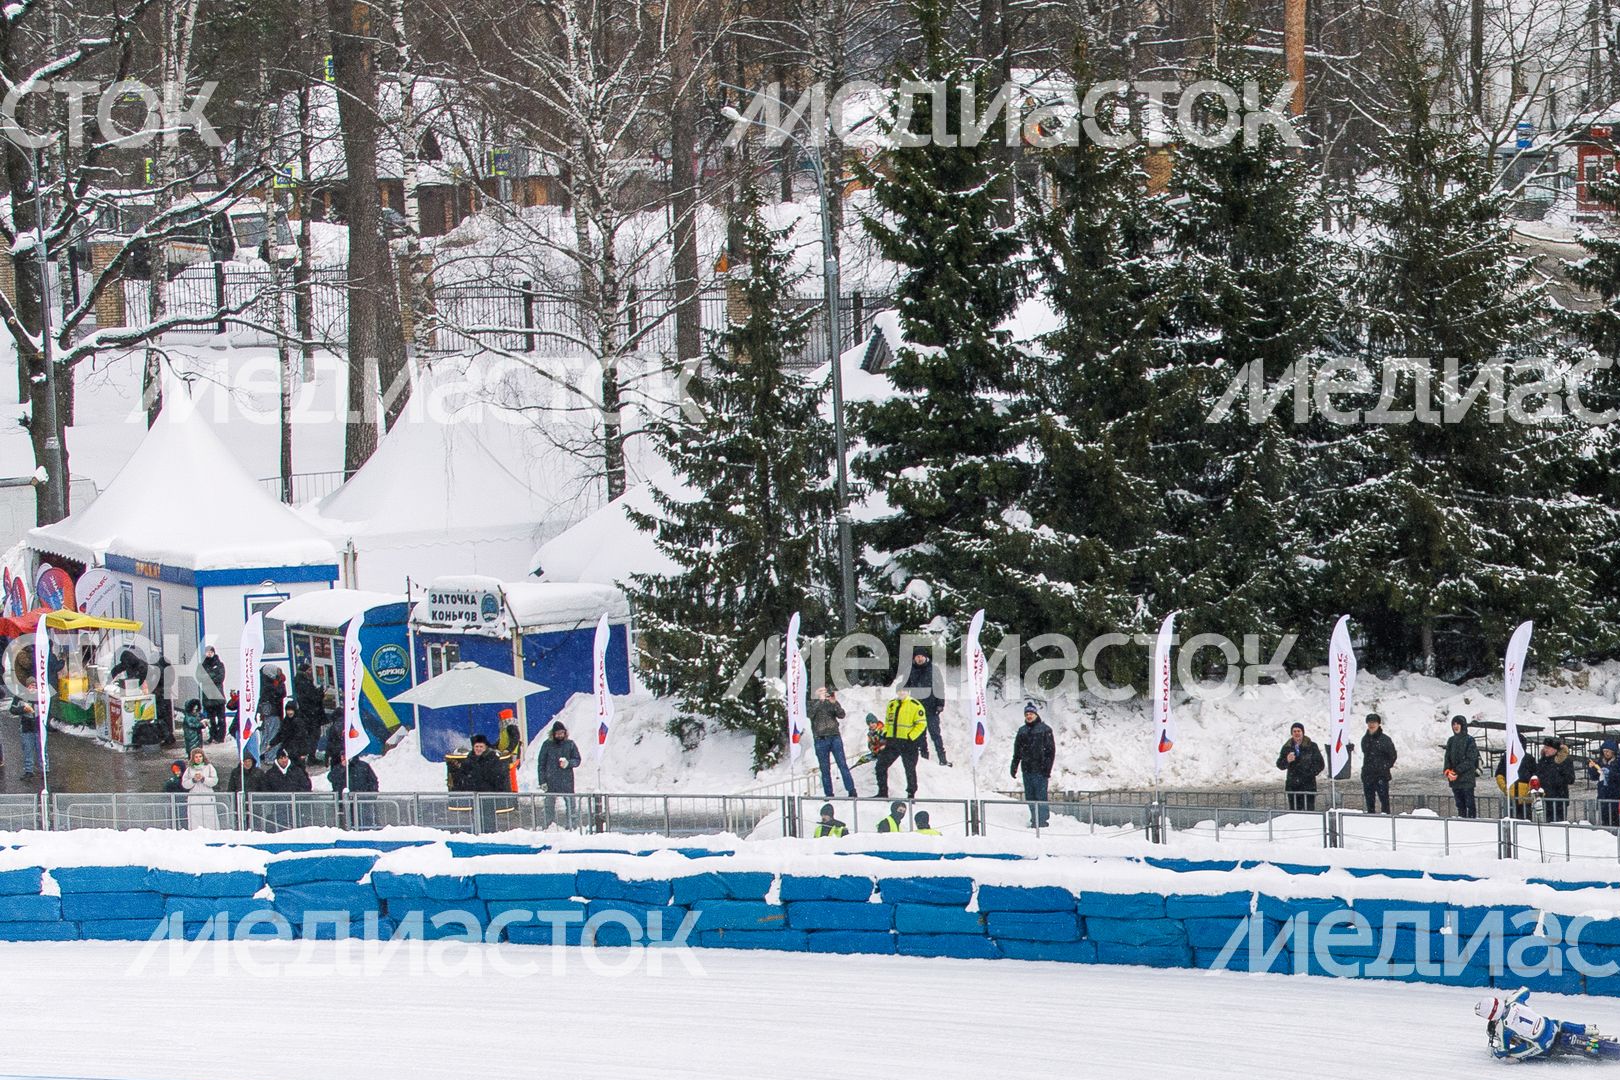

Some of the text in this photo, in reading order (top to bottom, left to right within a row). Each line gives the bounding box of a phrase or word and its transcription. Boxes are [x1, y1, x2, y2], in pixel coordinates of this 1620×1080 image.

[431, 593, 477, 605] ЗАТОЧКА
[431, 610, 477, 622] КОНЬКОВ
[1518, 1015, 1534, 1025] 1
